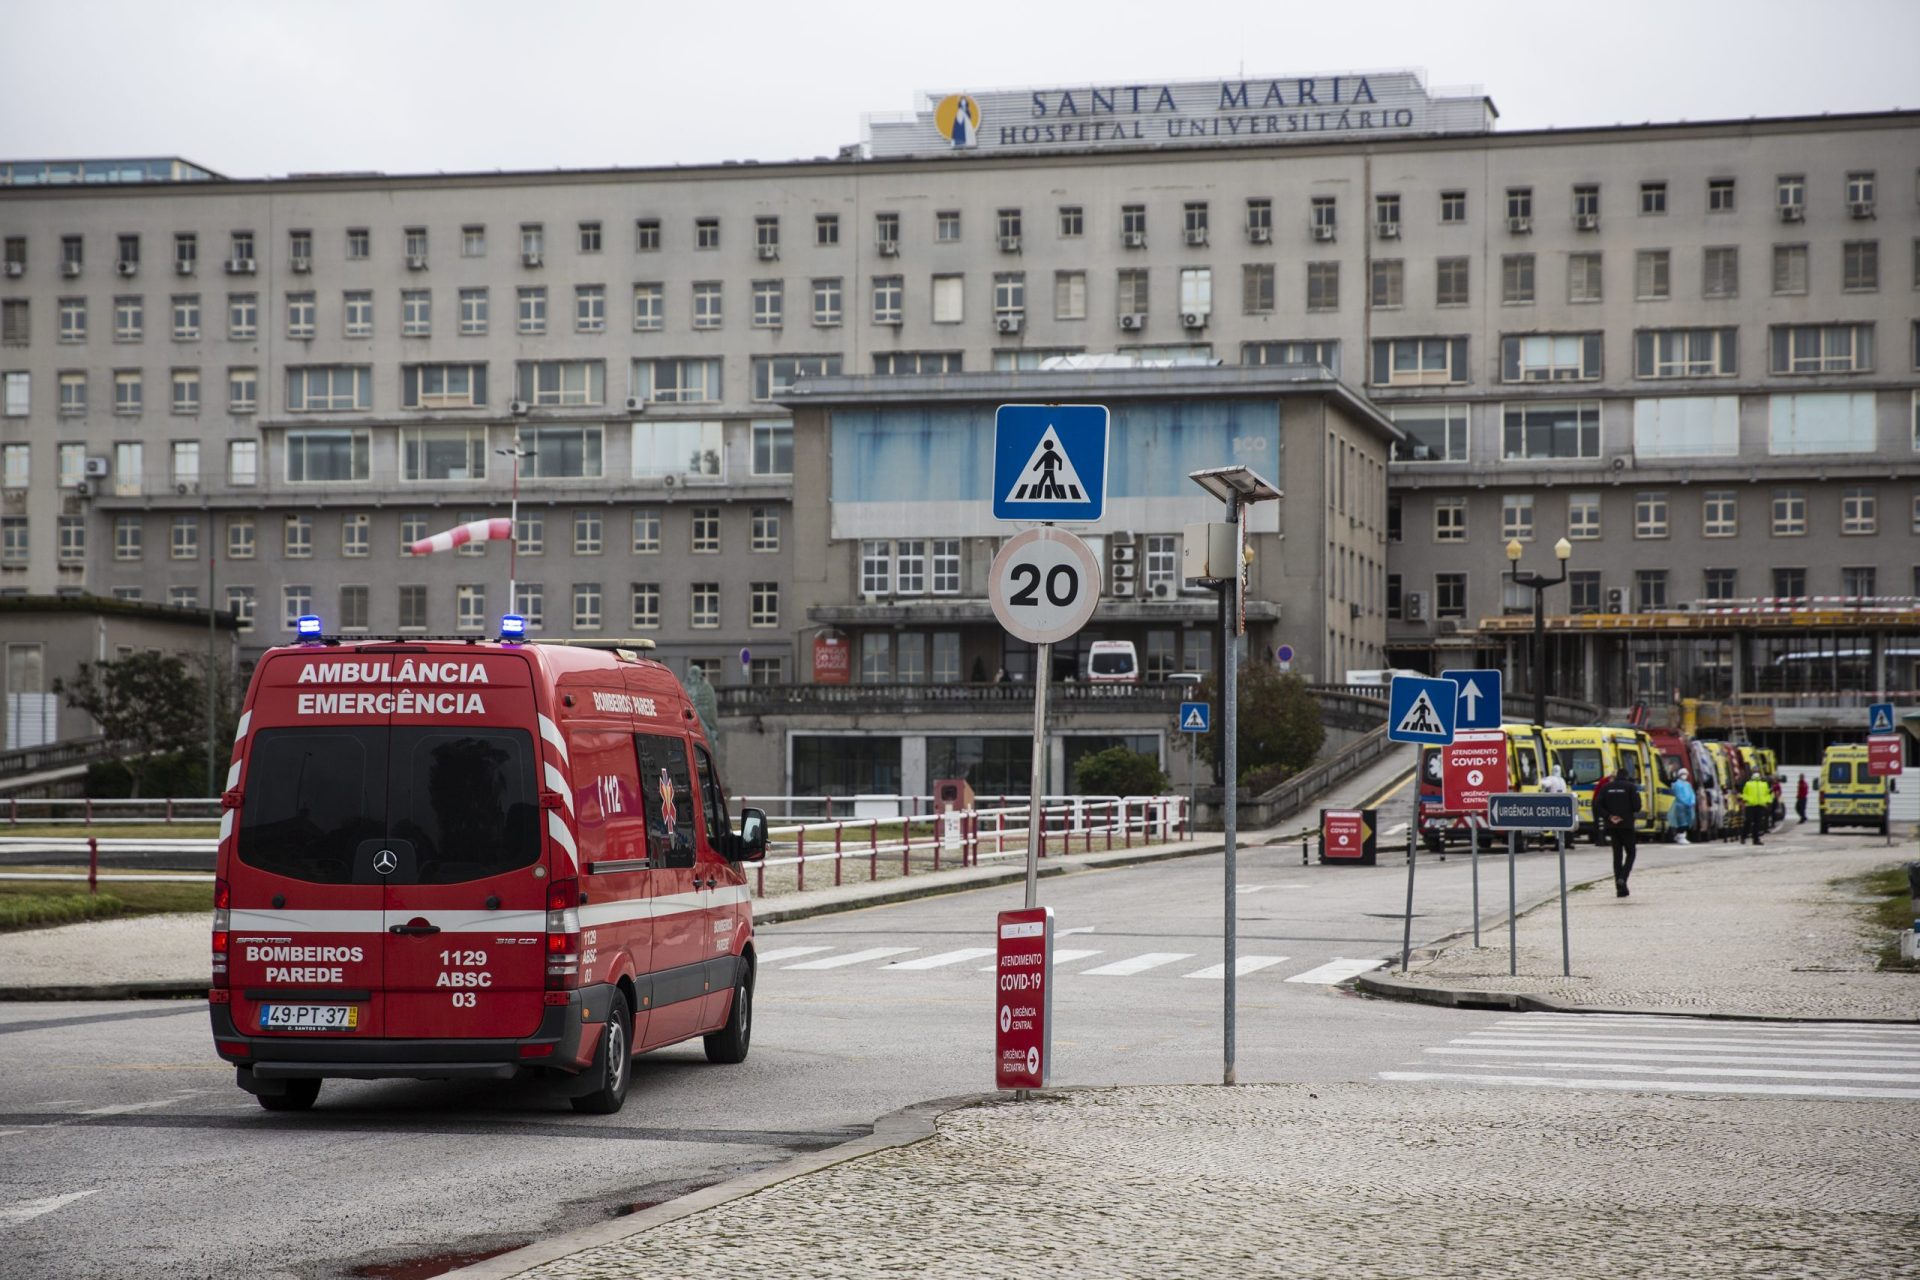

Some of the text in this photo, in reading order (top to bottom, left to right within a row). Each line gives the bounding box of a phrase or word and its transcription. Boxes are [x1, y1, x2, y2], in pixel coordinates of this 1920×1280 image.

[1032, 76, 1377, 119] SANTA MARIA
[1001, 109, 1413, 146] HOSPITAL UNIVERSITÁRIO
[1009, 563, 1079, 607] 20
[298, 659, 489, 683] AMBULÂNCIA
[298, 688, 485, 714] EMERGÊNCIA
[593, 692, 633, 713] BOMBEIROS
[1451, 748, 1498, 756] ATENDIMENTO
[1451, 757, 1498, 767] COVID-19
[604, 775, 621, 813] 112
[1461, 789, 1489, 797] URGÊNCIA
[1499, 804, 1571, 817] URGÊNCIA CENTRAL
[584, 930, 597, 946] 1129
[246, 946, 363, 962] BOMBEIROS
[440, 950, 487, 966] 1129
[582, 948, 597, 964] ABSC
[1001, 953, 1042, 967] ATENDIMENTO
[266, 968, 343, 982] PAREDE
[436, 972, 492, 987] ABSC
[584, 968, 592, 983] 03
[1001, 972, 1041, 991] COVID-19
[452, 992, 477, 1007] 03
[1012, 1006, 1036, 1017] URGÊNCIA
[1012, 1021, 1032, 1030] CENTRAL
[1003, 1049, 1025, 1060] URGÊNCIA
[1004, 1063, 1025, 1072] PEDIATRIA
